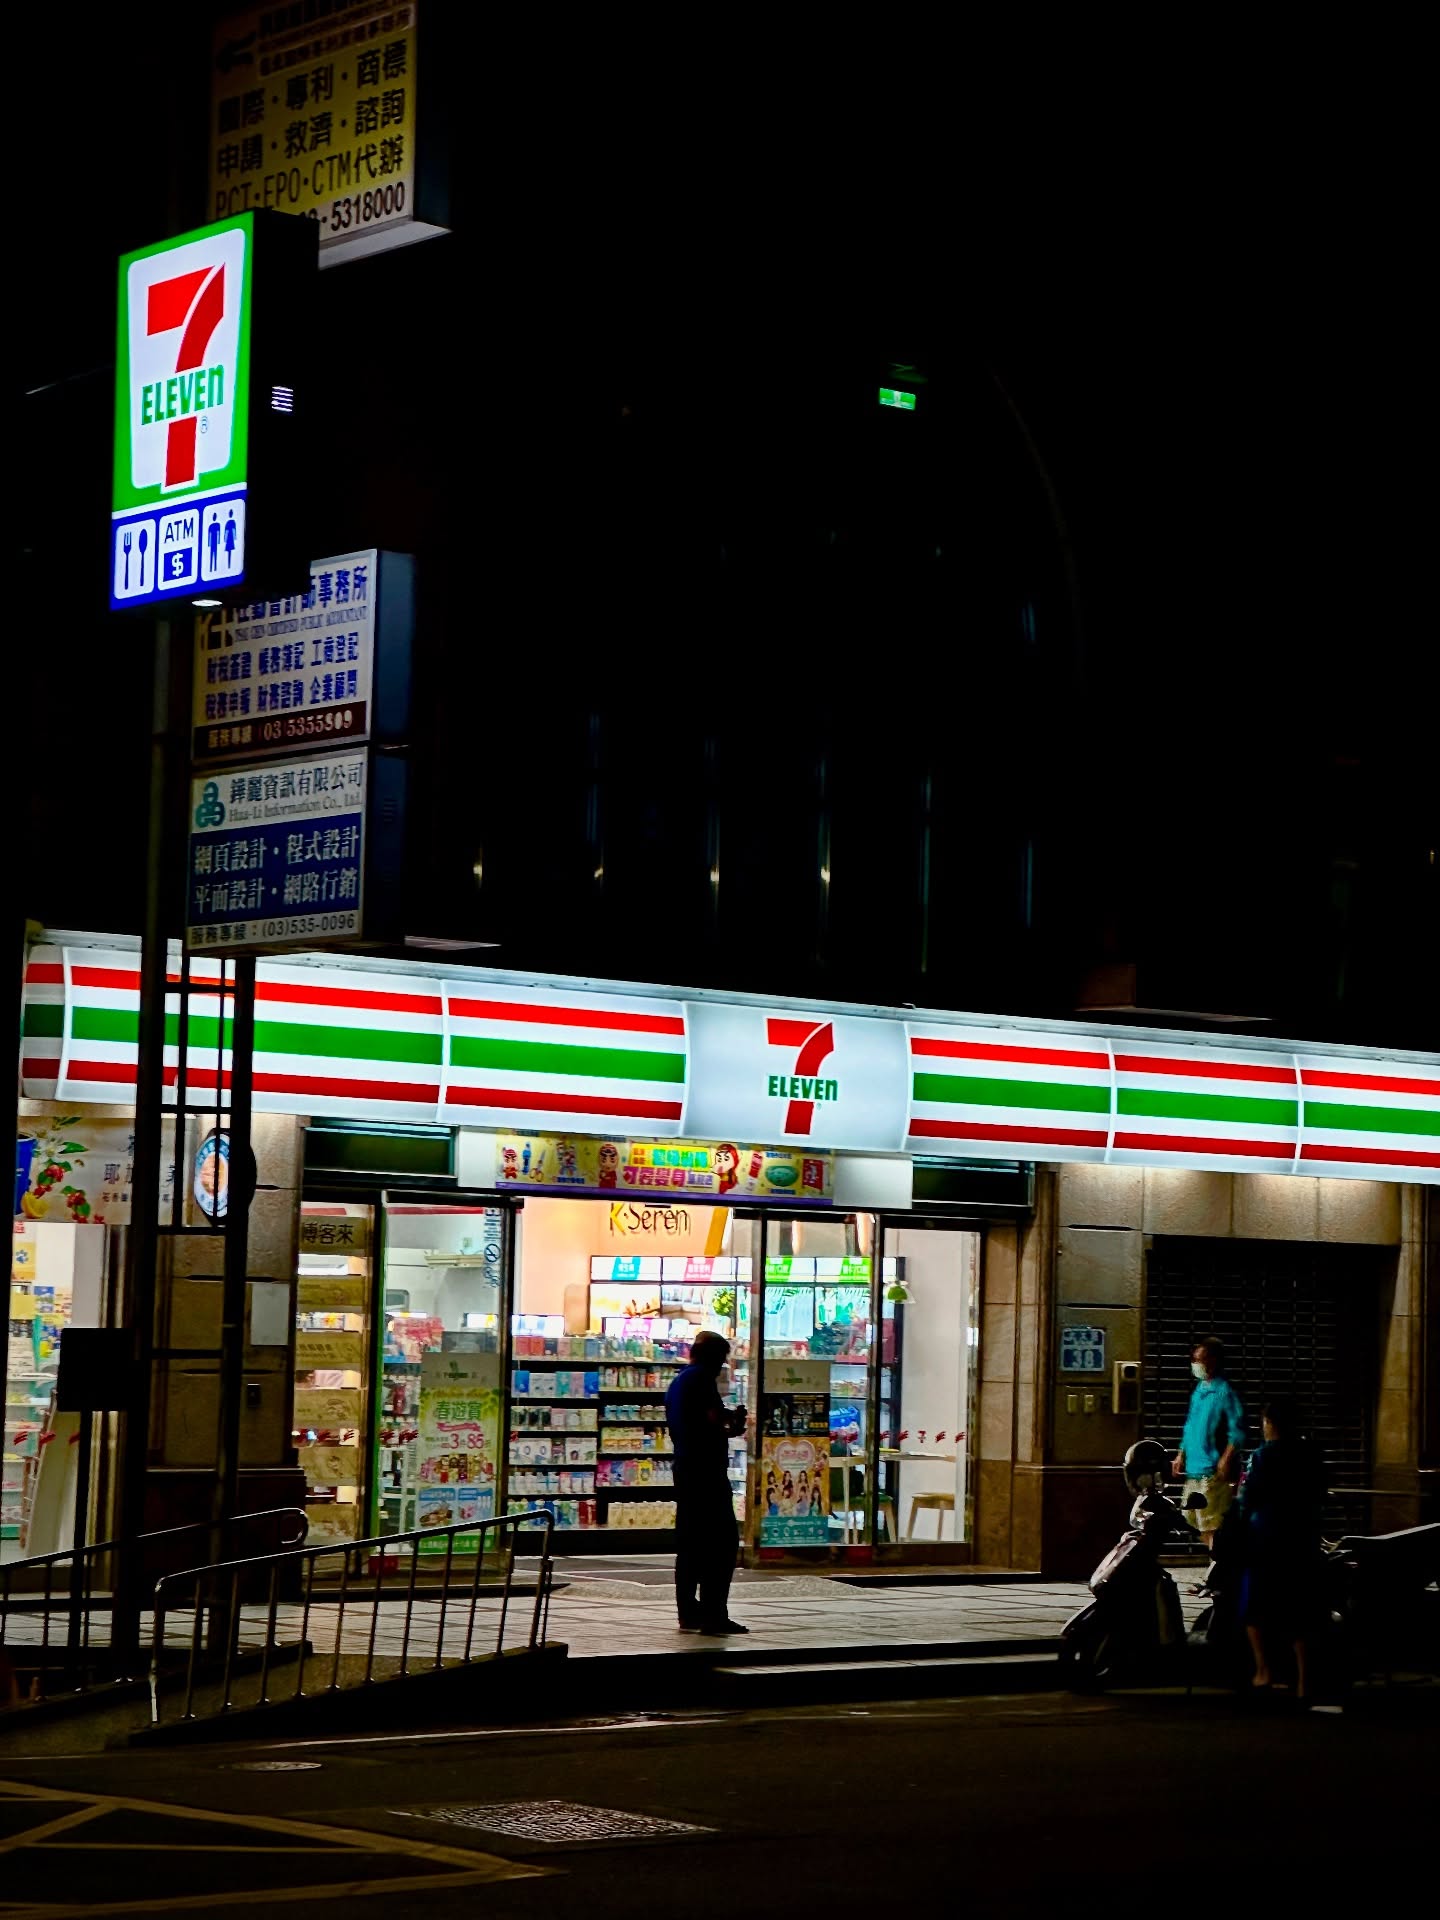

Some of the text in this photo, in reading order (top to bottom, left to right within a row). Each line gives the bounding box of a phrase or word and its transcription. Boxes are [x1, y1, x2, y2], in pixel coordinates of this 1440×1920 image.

[147, 262, 226, 488] 7
[164, 517, 194, 543] ATM
[311, 632, 359, 666] 工商登記
[766, 1018, 835, 1135] 7
[302, 1222, 354, 1245] 博客來
